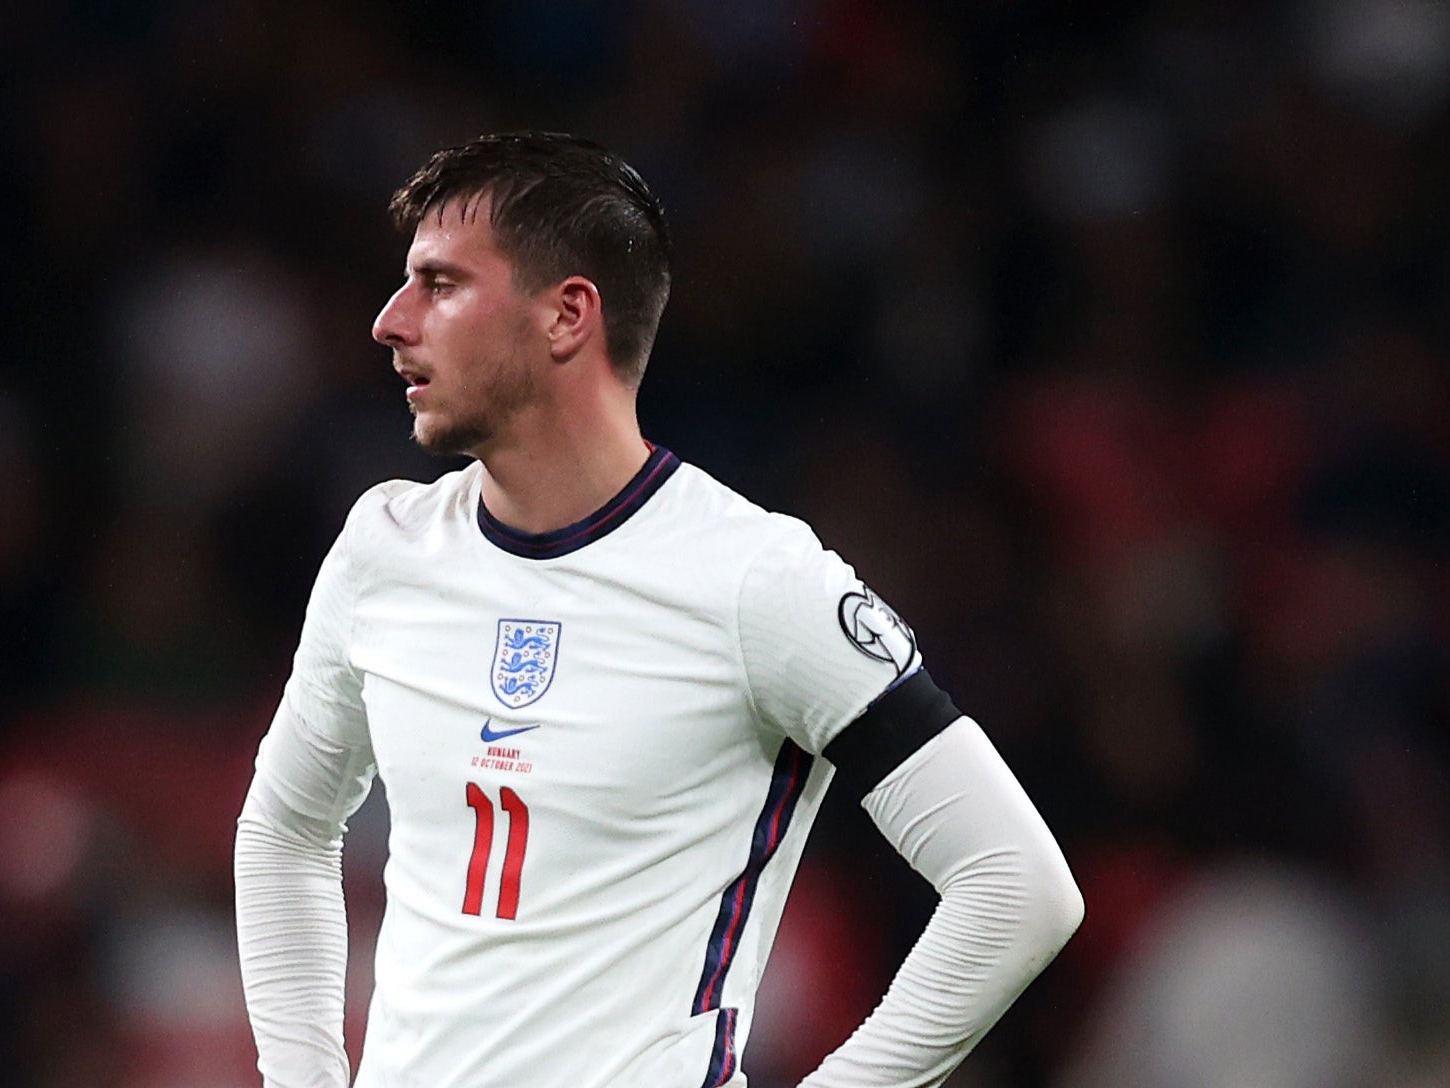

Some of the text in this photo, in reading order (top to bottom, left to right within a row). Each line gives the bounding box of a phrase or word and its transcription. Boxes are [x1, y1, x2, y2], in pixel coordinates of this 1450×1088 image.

[487, 746, 520, 759] HUNGARY
[471, 756, 533, 773] 12 OCTOBER 2021
[462, 782, 529, 920] 11
